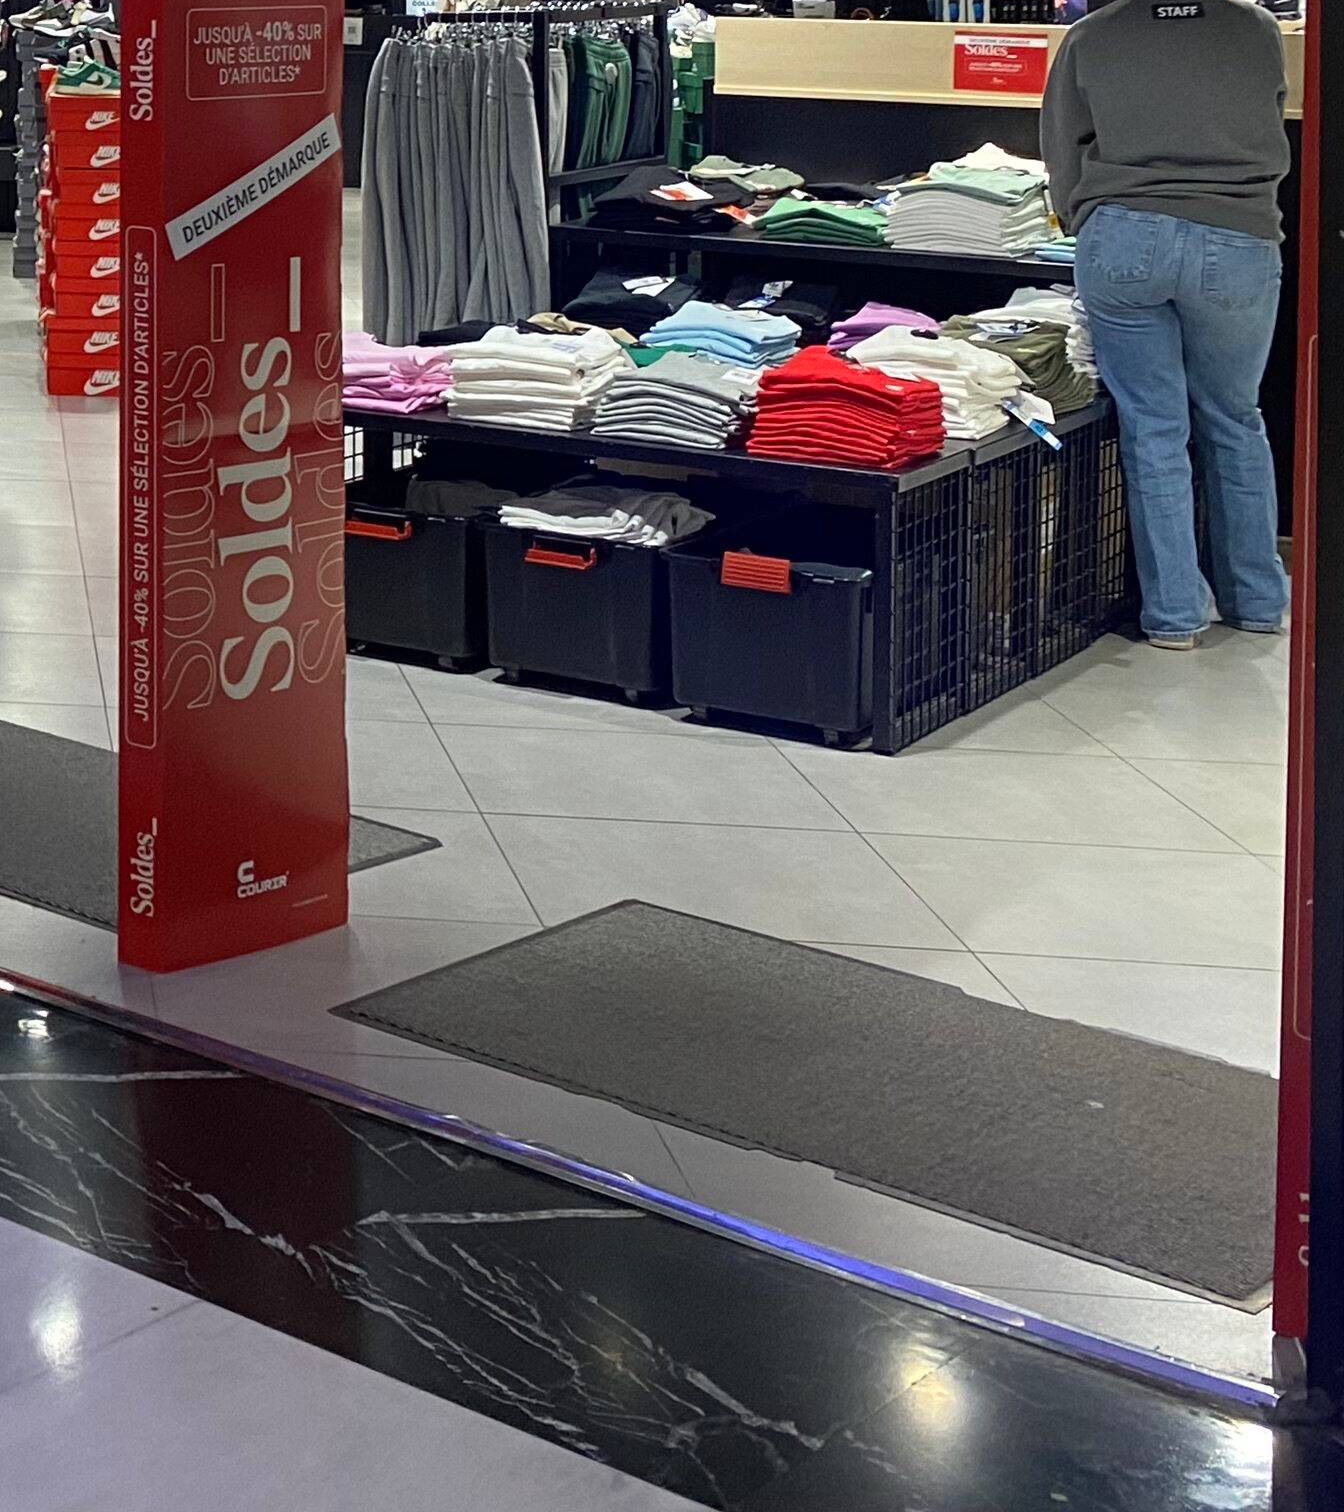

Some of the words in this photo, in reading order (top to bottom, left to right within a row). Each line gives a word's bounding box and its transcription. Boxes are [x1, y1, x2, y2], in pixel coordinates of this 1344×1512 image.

[1157, 5, 1198, 17] STAFF
[193, 23, 253, 45] JUSQU'À
[256, 21, 295, 42] -40%
[296, 23, 322, 40] SUR
[206, 47, 235, 65] UNE
[239, 41, 312, 64] SÉLECTION
[182, 183, 259, 244] DEUXIÈME
[258, 131, 331, 196] DÉMARQUE
[132, 379, 150, 491] SÉLECTION
[133, 495, 149, 535] UNE
[133, 540, 149, 583] SUR
[134, 587, 150, 633] -40%
[134, 638, 150, 722] JUSQU'À
